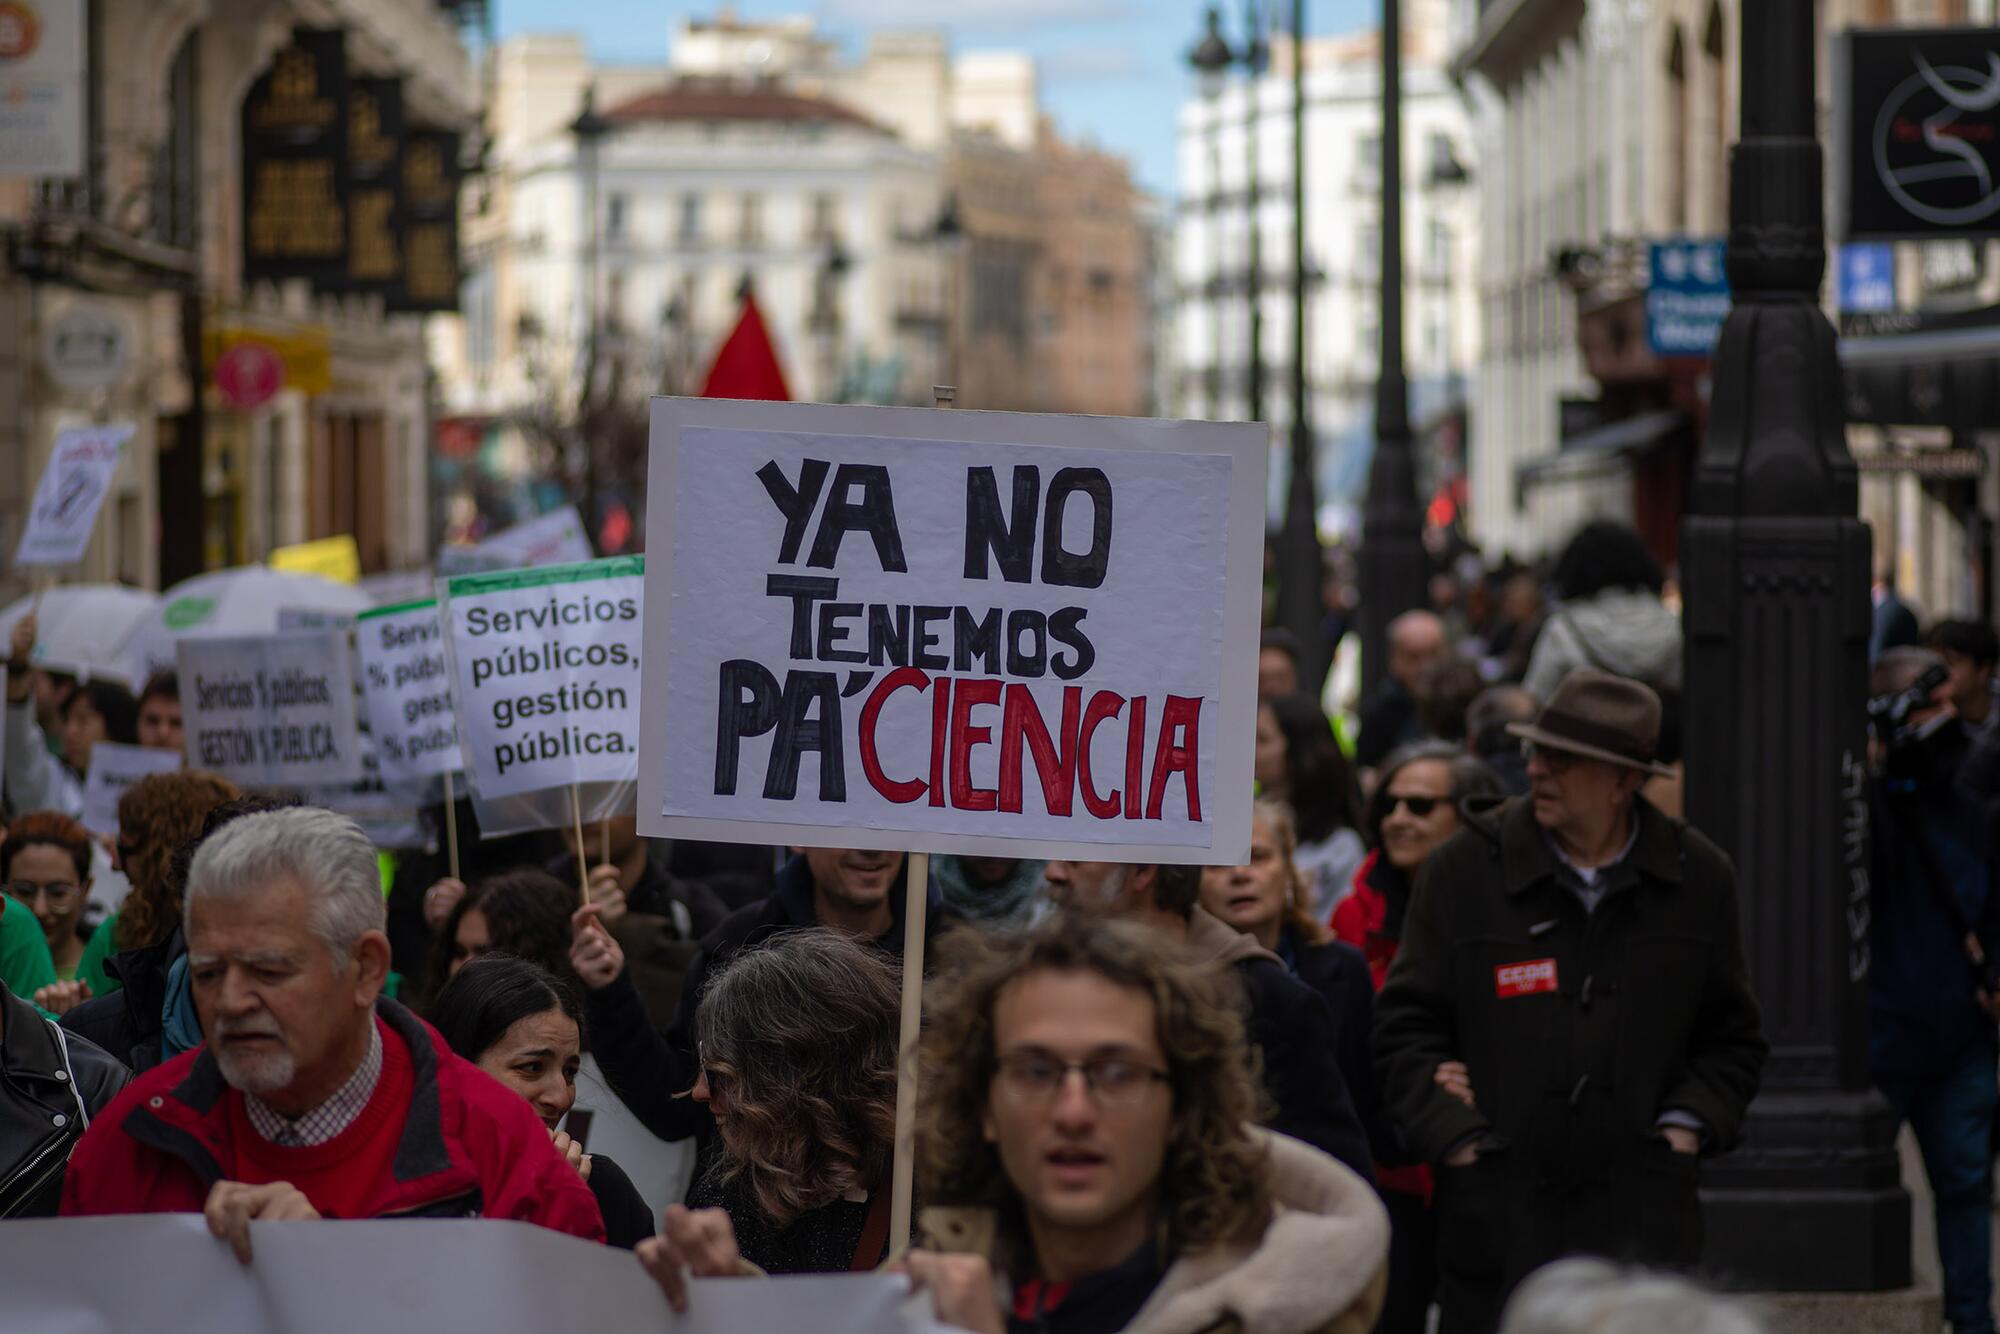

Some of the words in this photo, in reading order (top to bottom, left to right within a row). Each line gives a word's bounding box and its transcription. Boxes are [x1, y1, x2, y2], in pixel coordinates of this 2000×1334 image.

[755, 457, 907, 574] YA
[963, 465, 1113, 589] NO
[381, 617, 440, 649] Servi
[466, 596, 638, 636] Servicios
[766, 573, 1096, 680] TENEMOS
[395, 654, 446, 688] públ
[472, 641, 640, 688] públicos,
[404, 690, 453, 724] gest
[492, 680, 627, 729] gestión
[408, 724, 459, 760] públ
[494, 726, 635, 775] pública.
